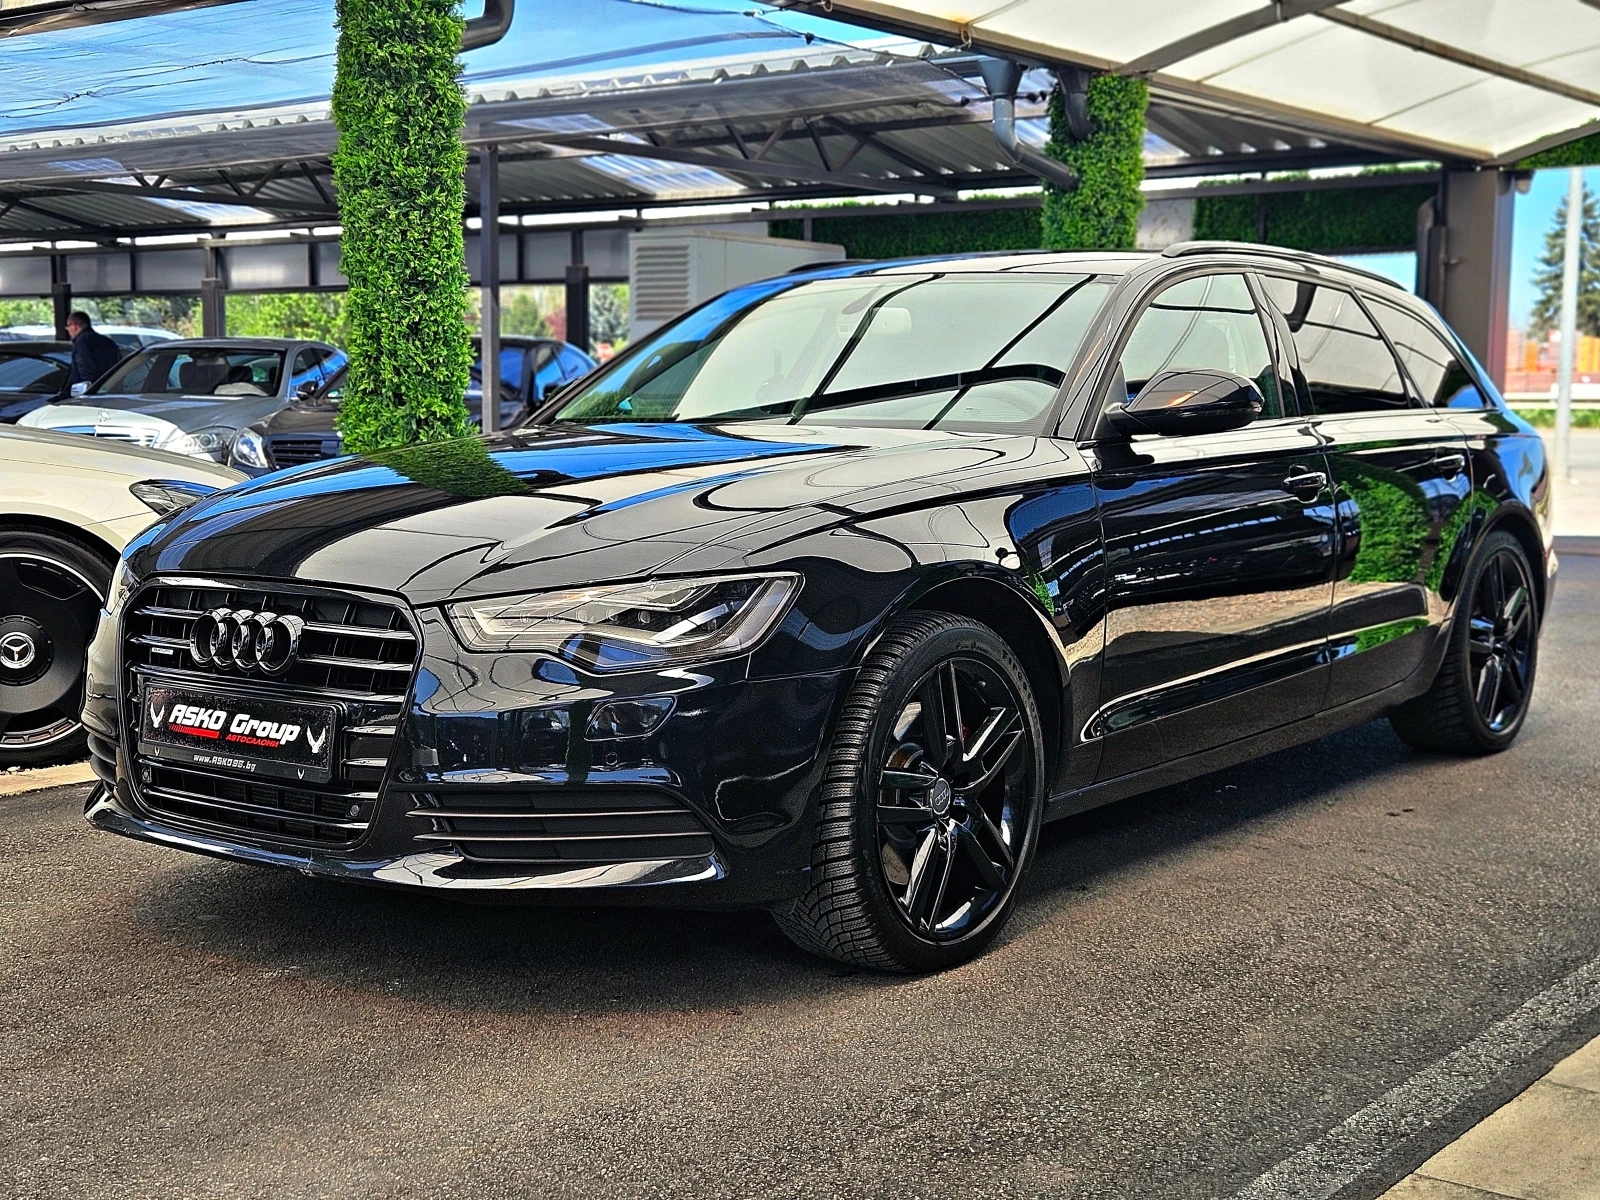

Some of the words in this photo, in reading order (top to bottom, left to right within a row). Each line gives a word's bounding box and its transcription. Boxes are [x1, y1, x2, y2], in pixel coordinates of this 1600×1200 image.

[168, 704, 227, 730] ASKO
[229, 713, 301, 745] Group
[226, 733, 280, 748] АВТОСАЛОНИ
